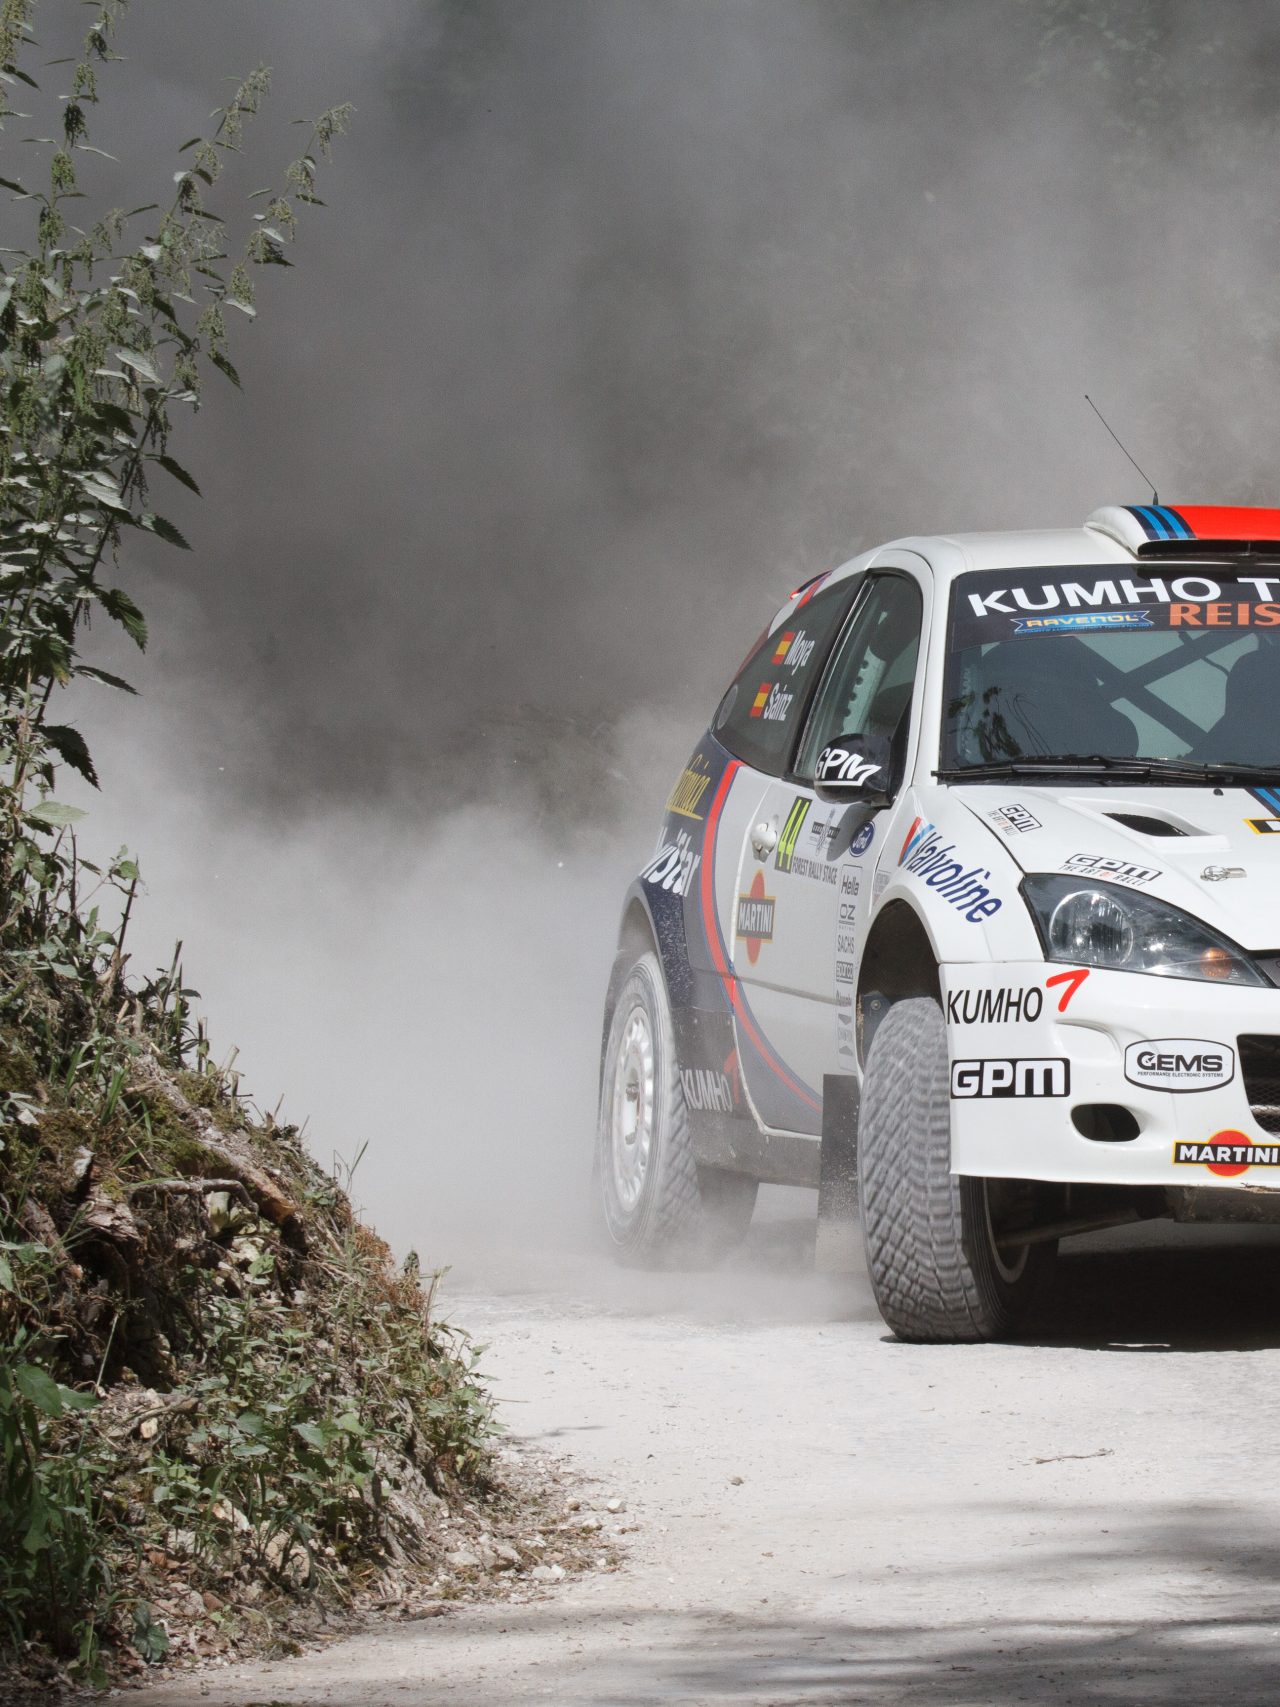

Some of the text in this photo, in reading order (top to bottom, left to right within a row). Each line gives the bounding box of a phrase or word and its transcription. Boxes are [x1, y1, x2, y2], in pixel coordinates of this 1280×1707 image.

[968, 577, 1221, 617] KUMHO
[784, 630, 815, 676] Moya
[763, 682, 794, 722] Sainz
[814, 747, 883, 787] GPM
[778, 799, 810, 871] 44
[999, 804, 1042, 832] GPM
[823, 864, 838, 885] STAGE
[903, 831, 1003, 923] Valvoline
[1066, 855, 1162, 881] GPM
[841, 875, 859, 896] Hella
[739, 902, 774, 933] MARTINI
[839, 903, 856, 920] OZ
[837, 934, 854, 954] SACHS
[947, 986, 1043, 1024] KUMHO
[951, 1059, 1068, 1098] GPM
[1137, 1051, 1223, 1072] GEMS
[680, 1069, 732, 1112] KUMHO
[1179, 1144, 1279, 1164] MARTINI
